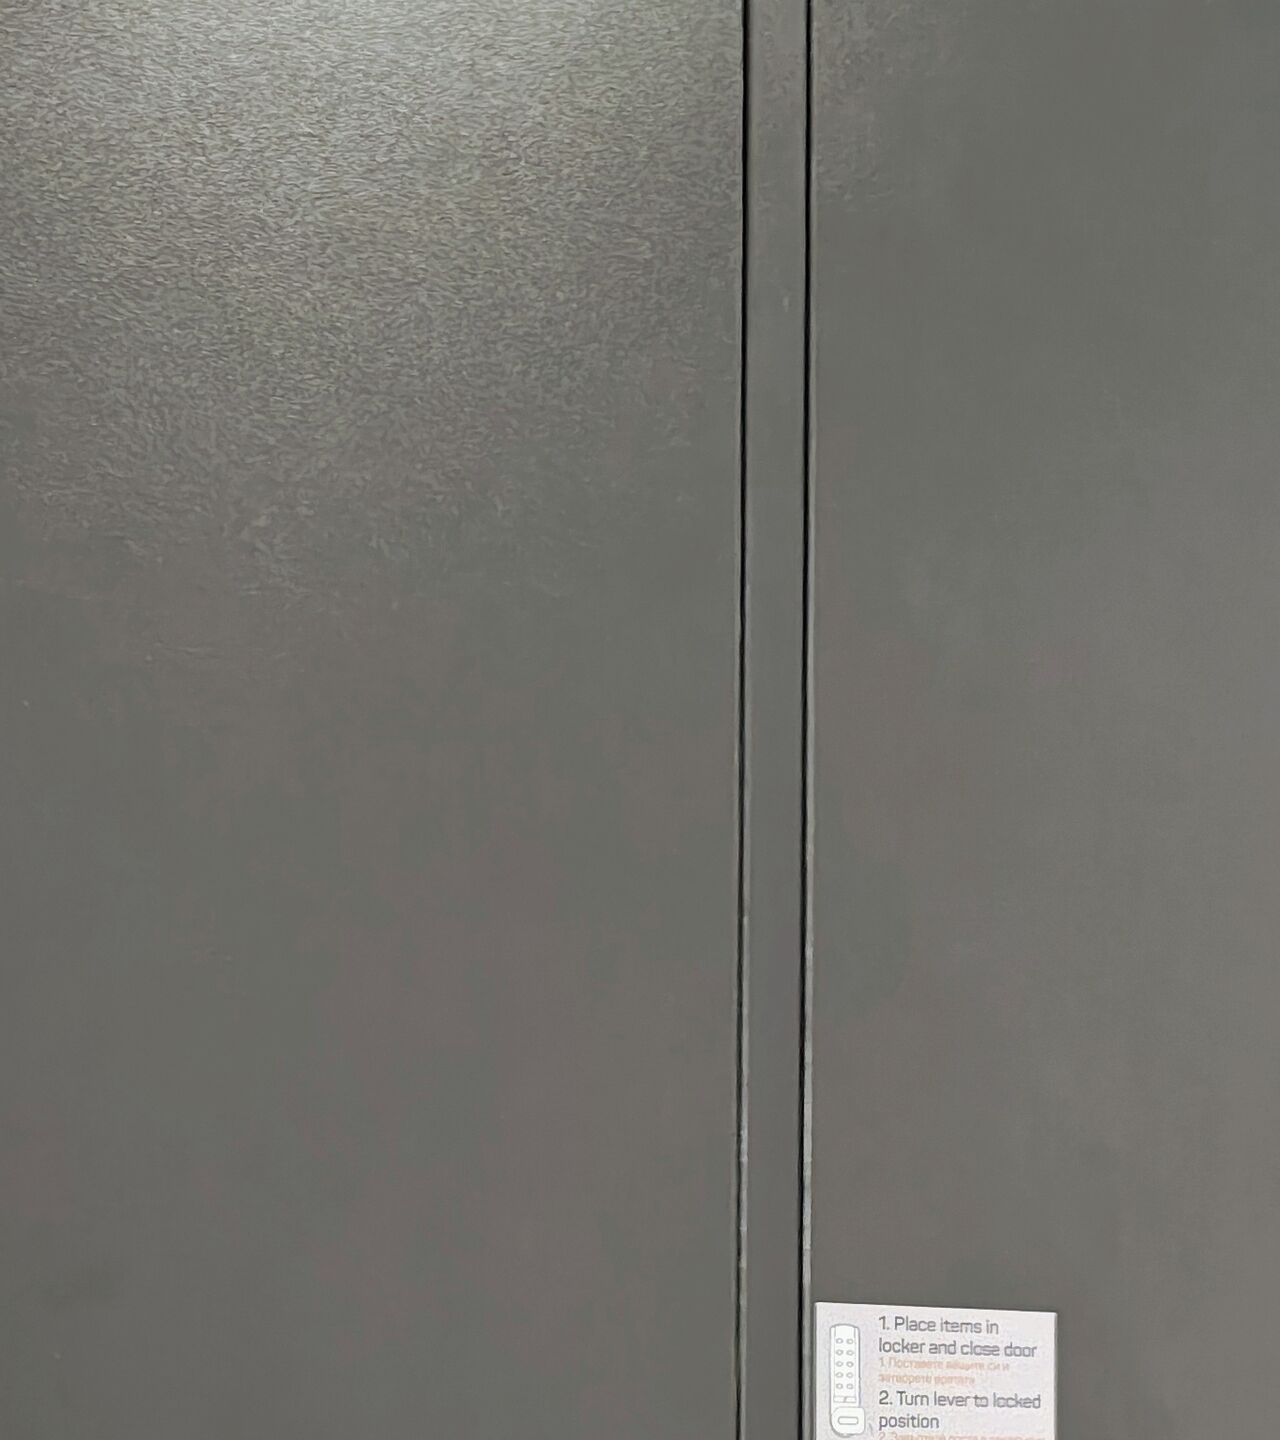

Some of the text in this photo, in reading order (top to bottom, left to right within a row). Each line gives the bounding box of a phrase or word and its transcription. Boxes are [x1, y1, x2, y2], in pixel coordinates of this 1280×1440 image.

[878, 1315, 999, 1335] 1. Place items in
[878, 1337, 1037, 1358] locker and close door
[878, 1389, 1041, 1409] 2. Turn lever to locked
[878, 1413, 940, 1431] position
